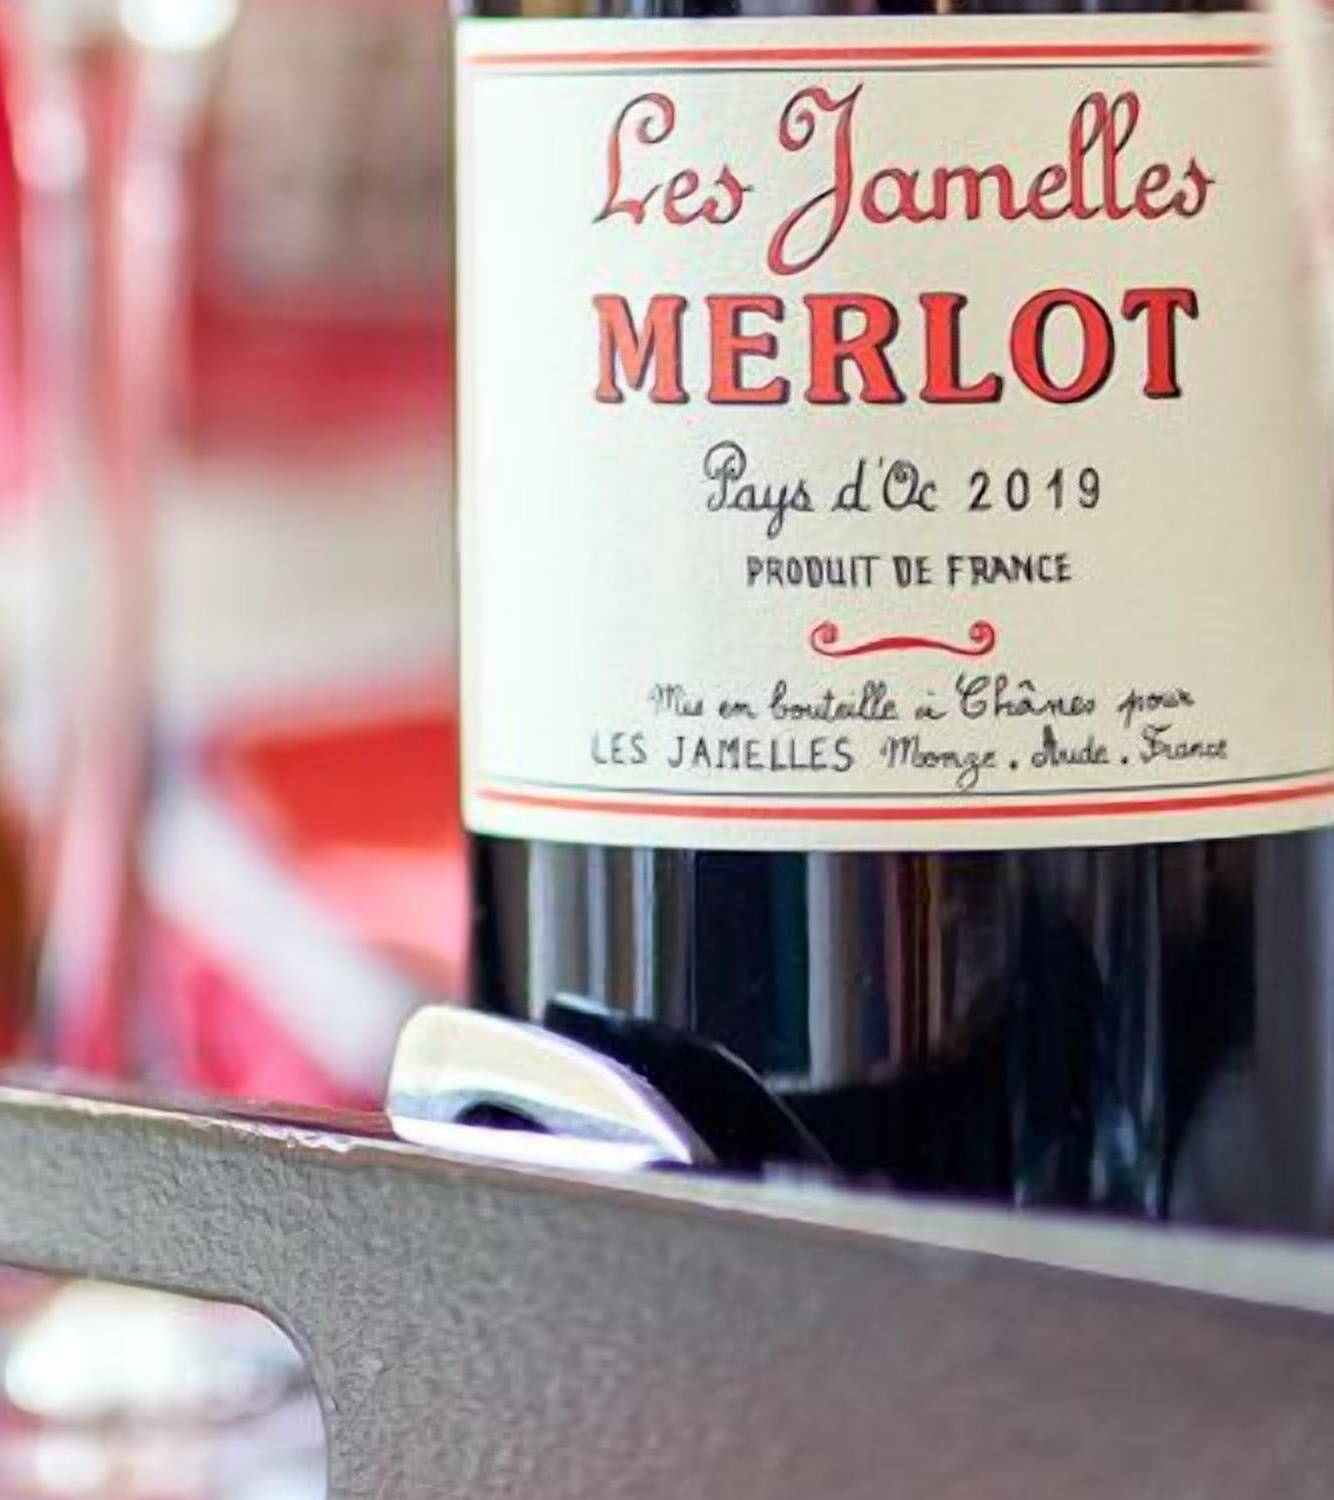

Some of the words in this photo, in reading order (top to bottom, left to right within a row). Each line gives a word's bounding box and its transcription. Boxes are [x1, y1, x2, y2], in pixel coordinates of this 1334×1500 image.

[593, 92, 754, 226] Les
[767, 83, 1215, 276] Jamelles
[592, 288, 1199, 405] MERLOT
[704, 440, 814, 539] Pays
[831, 455, 938, 512] d'Oc
[970, 466, 1101, 510] 2019
[746, 553, 881, 587] PRODUIT
[894, 553, 932, 586] DE
[947, 551, 1073, 585] FRANCE
[718, 697, 756, 720] en
[769, 679, 900, 723] bouteille
[590, 731, 648, 766] LES
[667, 735, 855, 772] JAMELLES
